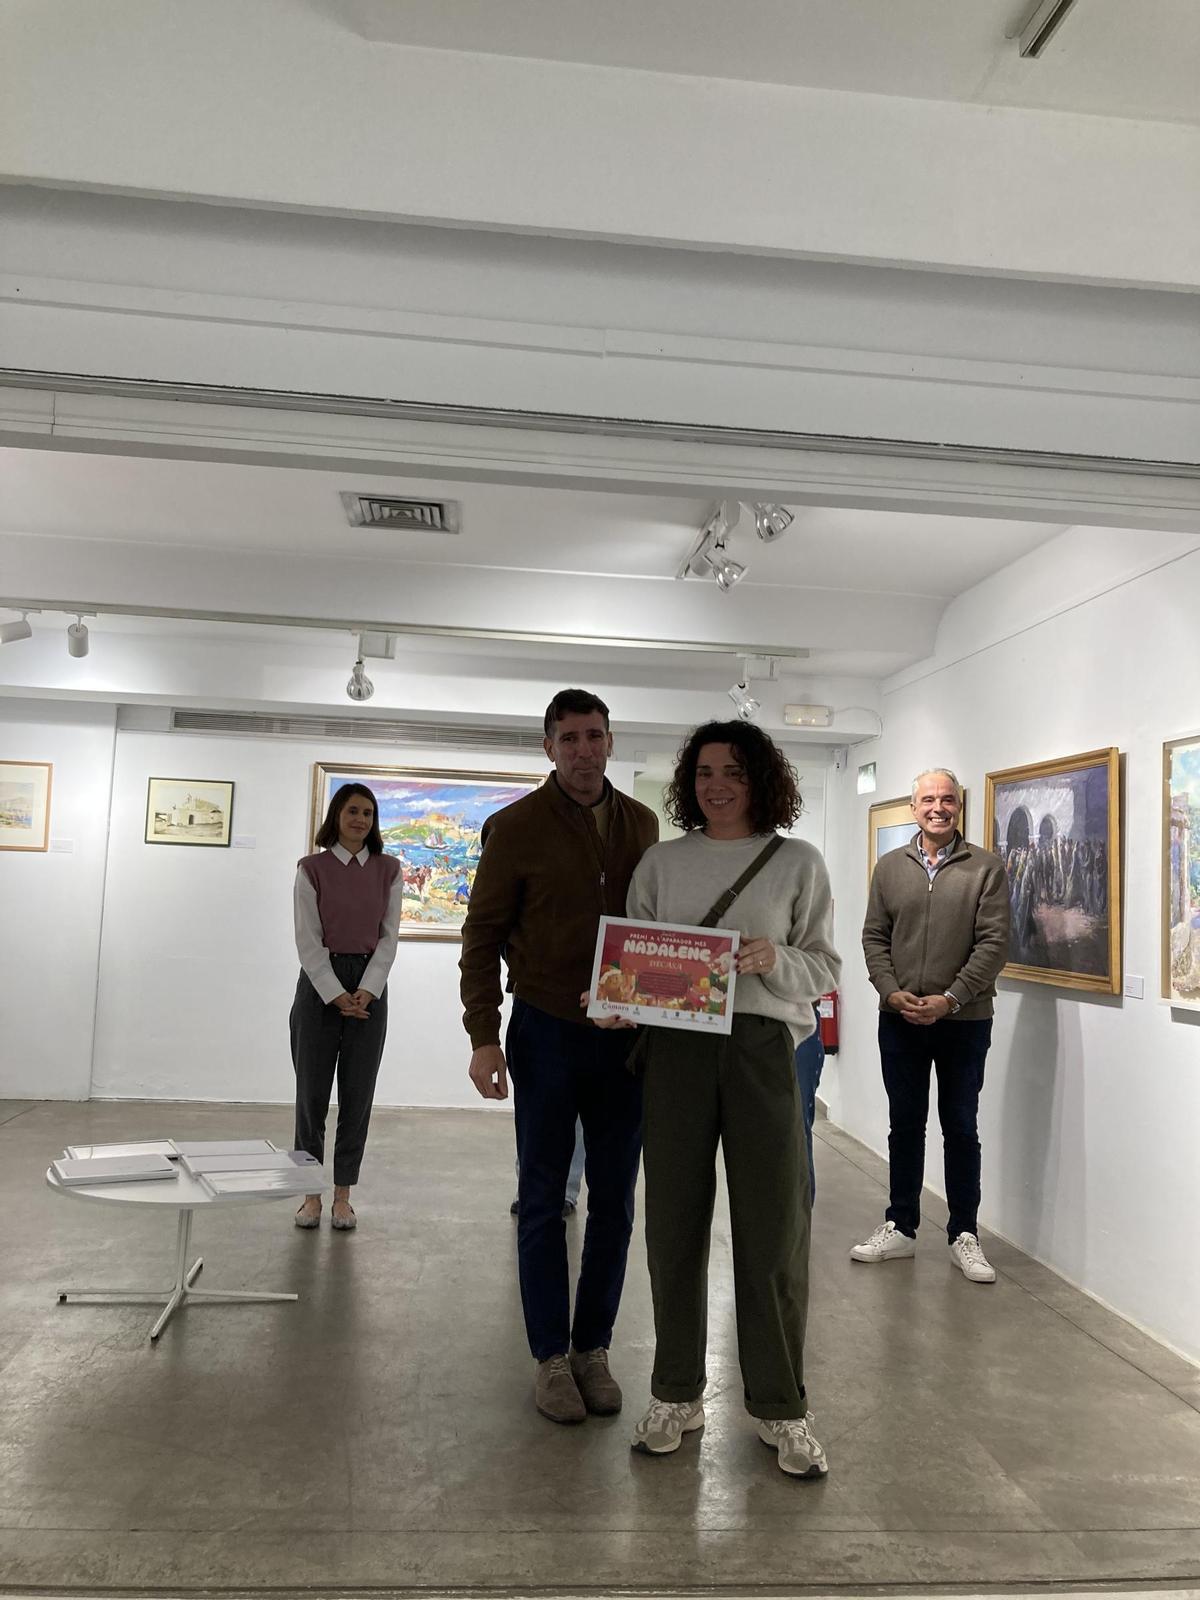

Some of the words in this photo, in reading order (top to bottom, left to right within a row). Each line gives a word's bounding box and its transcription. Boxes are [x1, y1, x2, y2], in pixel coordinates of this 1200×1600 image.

[630, 933, 648, 941] PREMI
[657, 935, 692, 945] L'APARADOR
[623, 939, 711, 962] NADALENC
